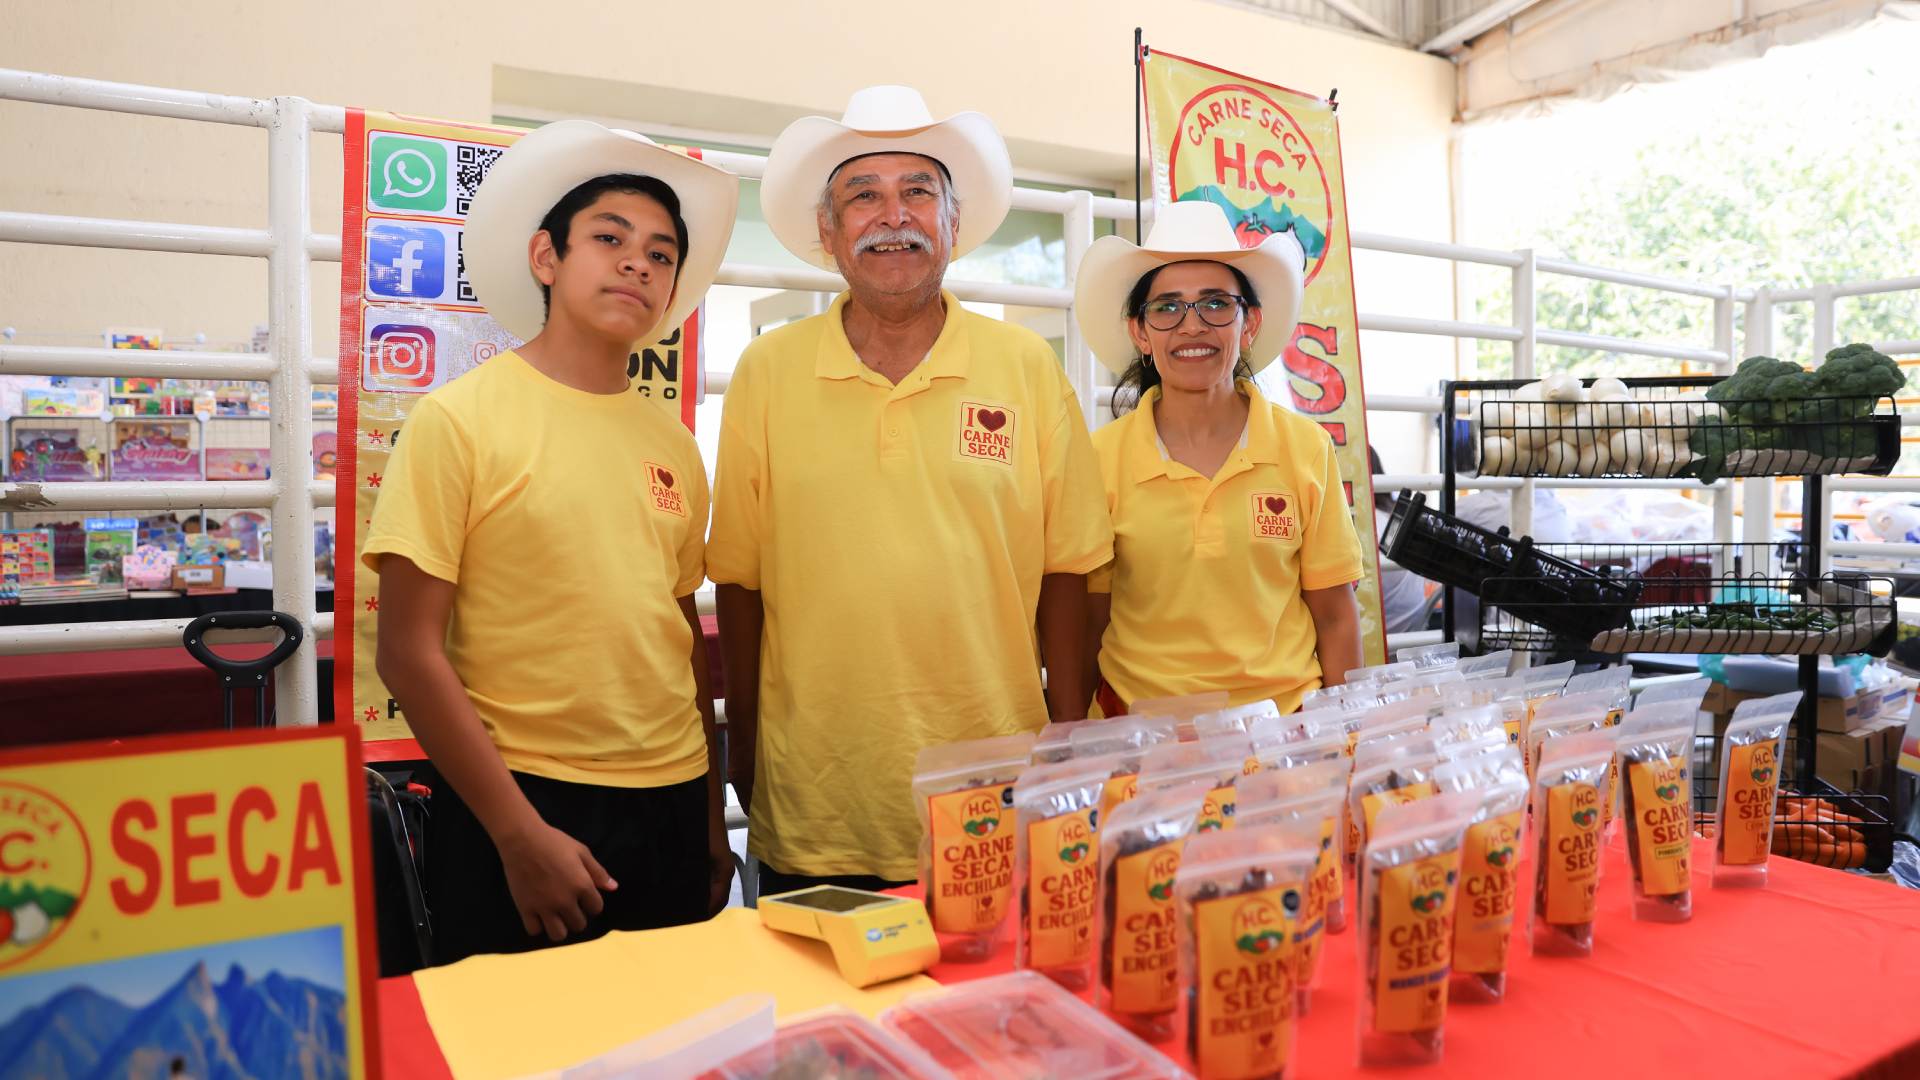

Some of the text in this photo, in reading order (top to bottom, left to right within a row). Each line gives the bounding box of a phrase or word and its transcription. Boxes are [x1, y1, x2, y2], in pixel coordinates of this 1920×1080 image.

[1188, 97, 1307, 171] CARNE SECA
[1214, 137, 1296, 199] H.C.
[966, 407, 975, 428] I
[963, 429, 1010, 449] CARNE
[968, 442, 1007, 460] SECA
[649, 466, 657, 484] I
[652, 486, 682, 503] CARNE
[656, 497, 682, 513] SECA
[1257, 496, 1264, 513] I
[1256, 514, 1293, 527] CARNE
[1261, 525, 1289, 537] SECA
[1734, 785, 1775, 804] CARN
[968, 800, 996, 817] H.C.
[1644, 801, 1689, 826] CARN
[1739, 802, 1773, 820] SEC
[109, 781, 343, 918] SECA
[943, 835, 1014, 863] CARNE
[952, 854, 1011, 881] SECA
[1565, 849, 1598, 873] SEC
[942, 869, 1013, 898] ENCHILAD
[1041, 864, 1096, 895] CARN
[1125, 906, 1176, 933] CAR
[1397, 940, 1445, 971] SEC
